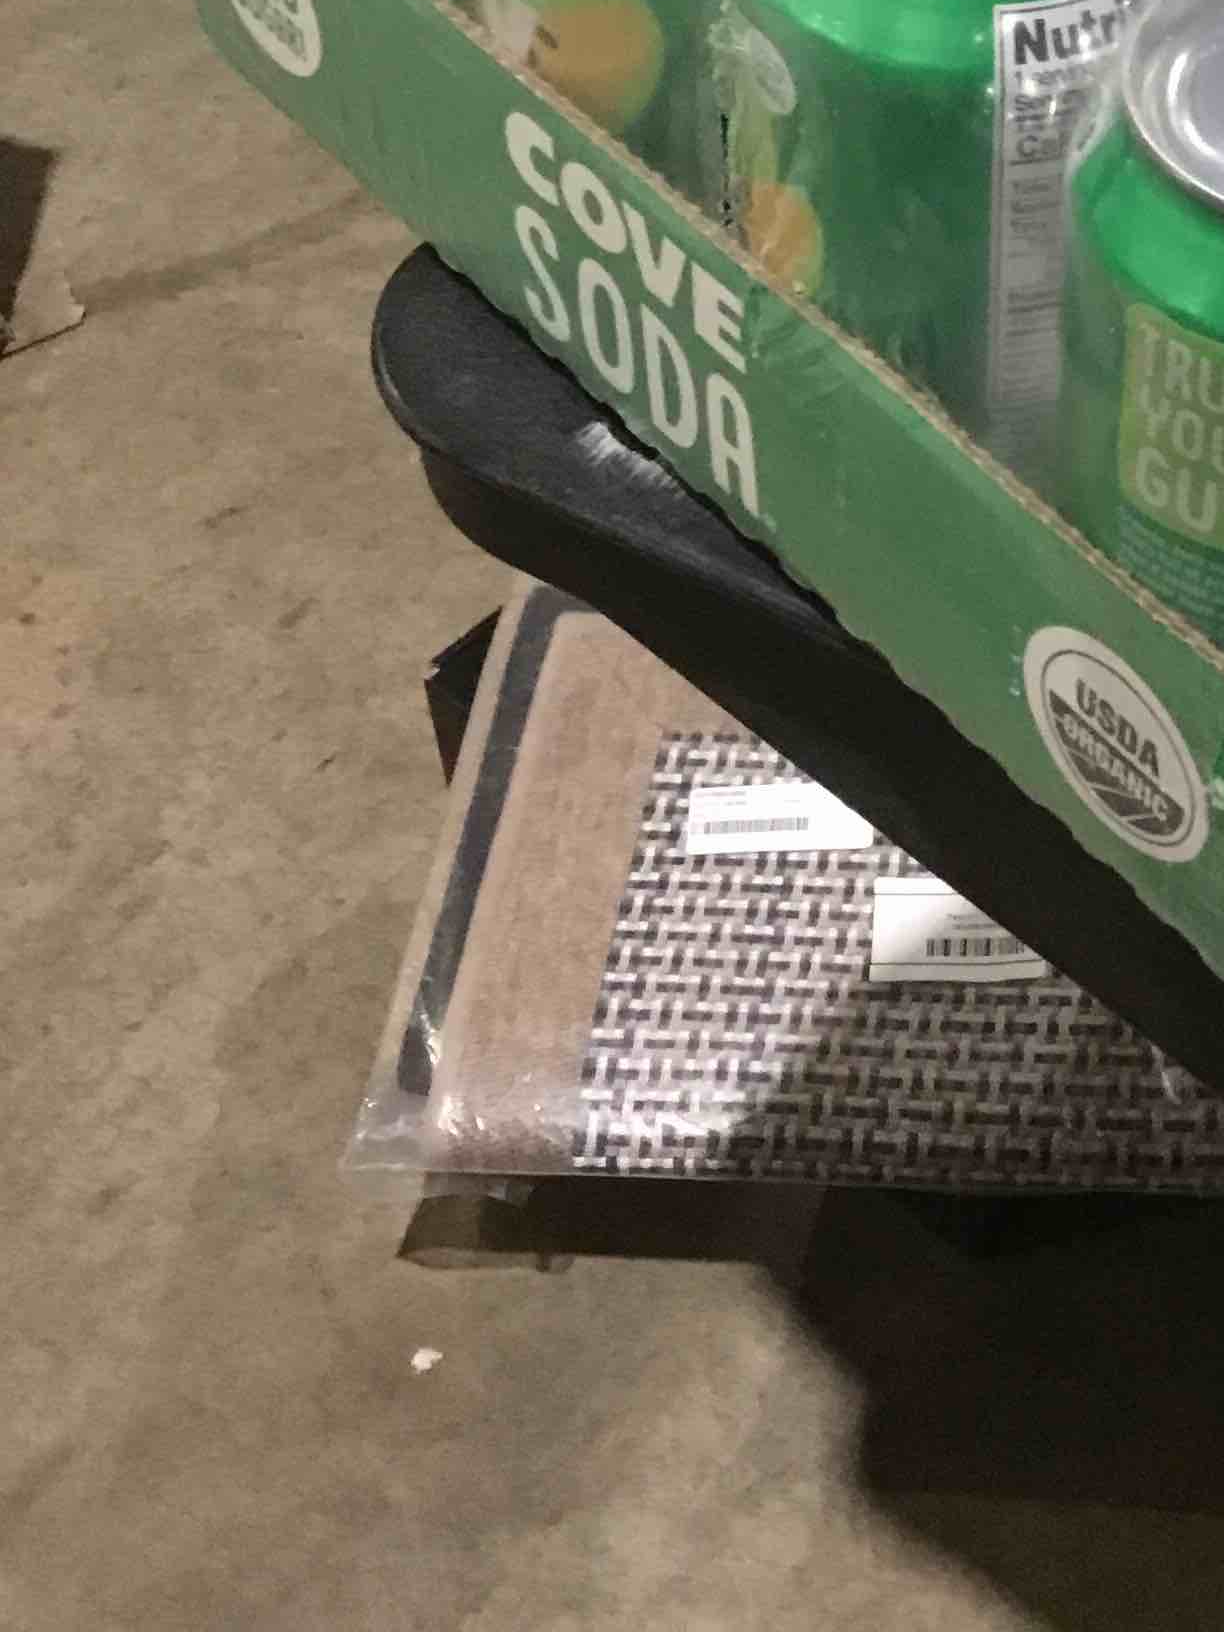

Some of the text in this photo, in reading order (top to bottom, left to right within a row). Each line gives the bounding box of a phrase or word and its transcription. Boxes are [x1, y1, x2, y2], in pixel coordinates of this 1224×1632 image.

[505, 111, 747, 375] COVE
[514, 205, 760, 519] SODA
[1062, 712, 1168, 823] ORGANIC
[1075, 676, 1161, 779] USDA
